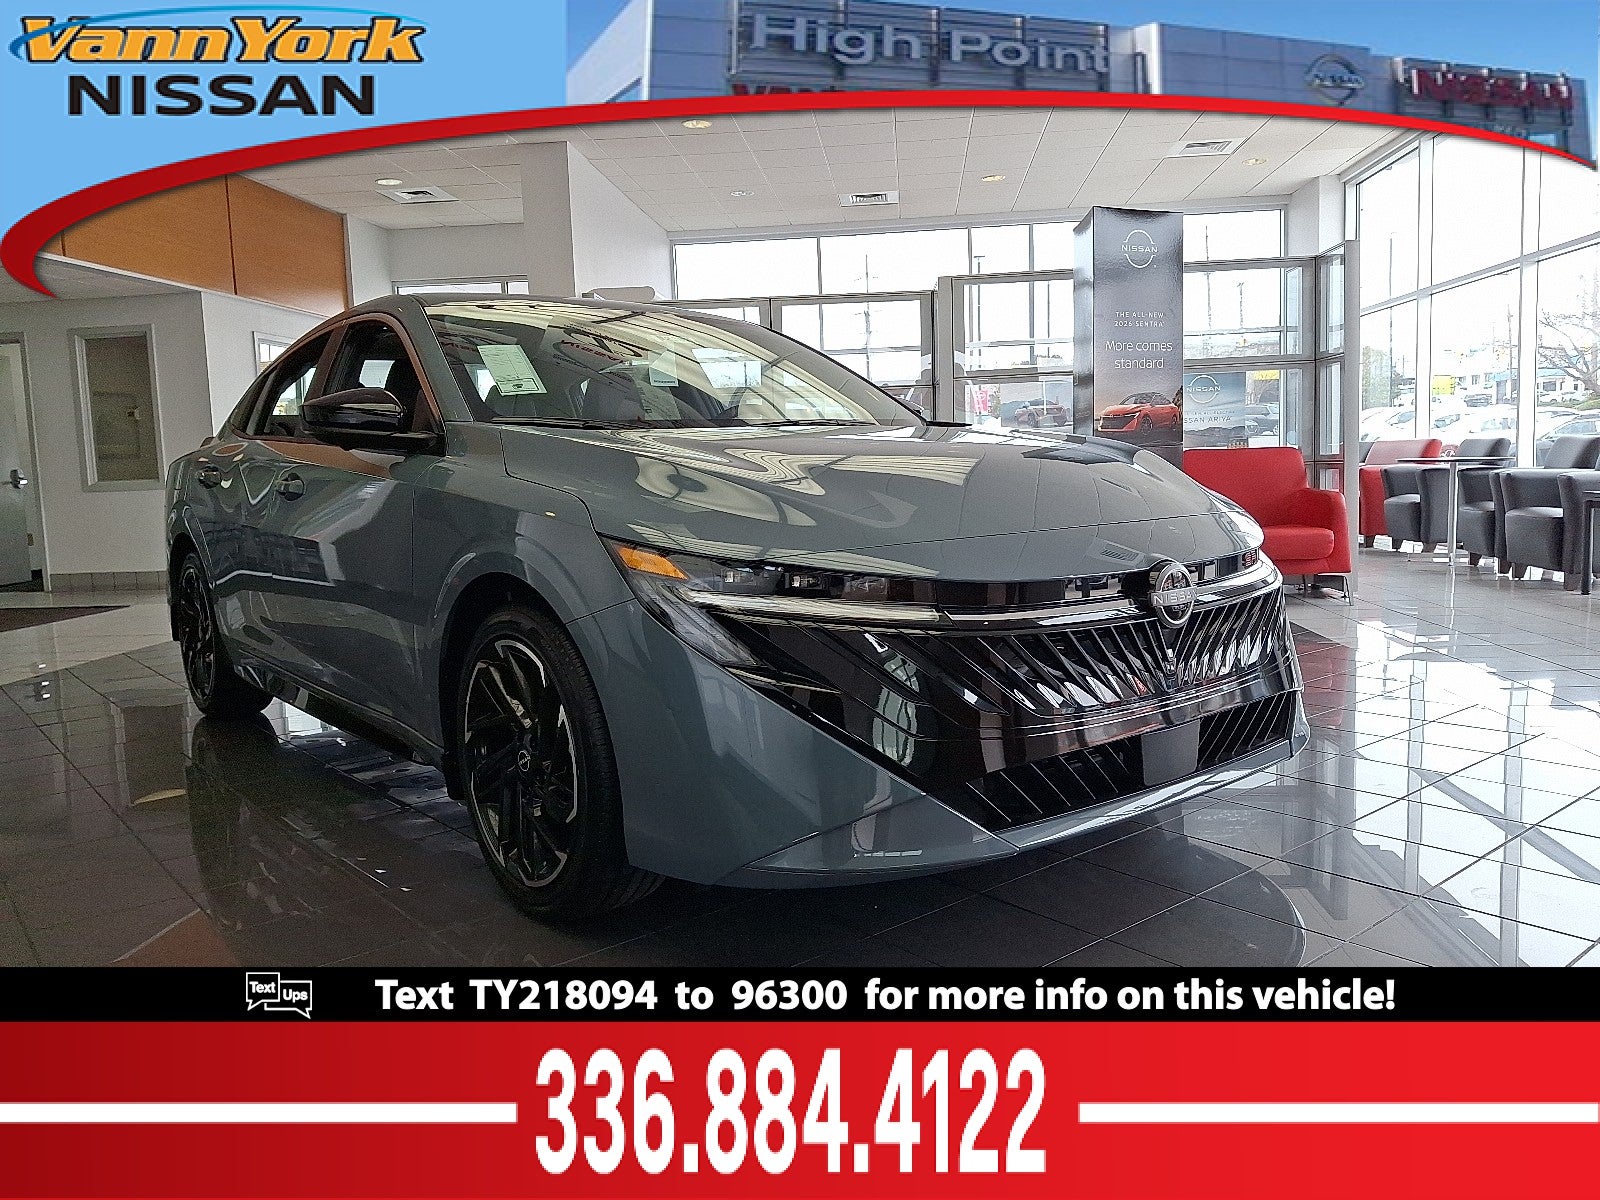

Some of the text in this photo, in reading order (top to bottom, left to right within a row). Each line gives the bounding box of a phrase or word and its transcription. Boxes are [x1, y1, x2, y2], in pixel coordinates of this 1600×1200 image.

[1121, 244, 1158, 253] NISSAN
[1105, 340, 1173, 351] More comes
[1114, 357, 1165, 369] standard
